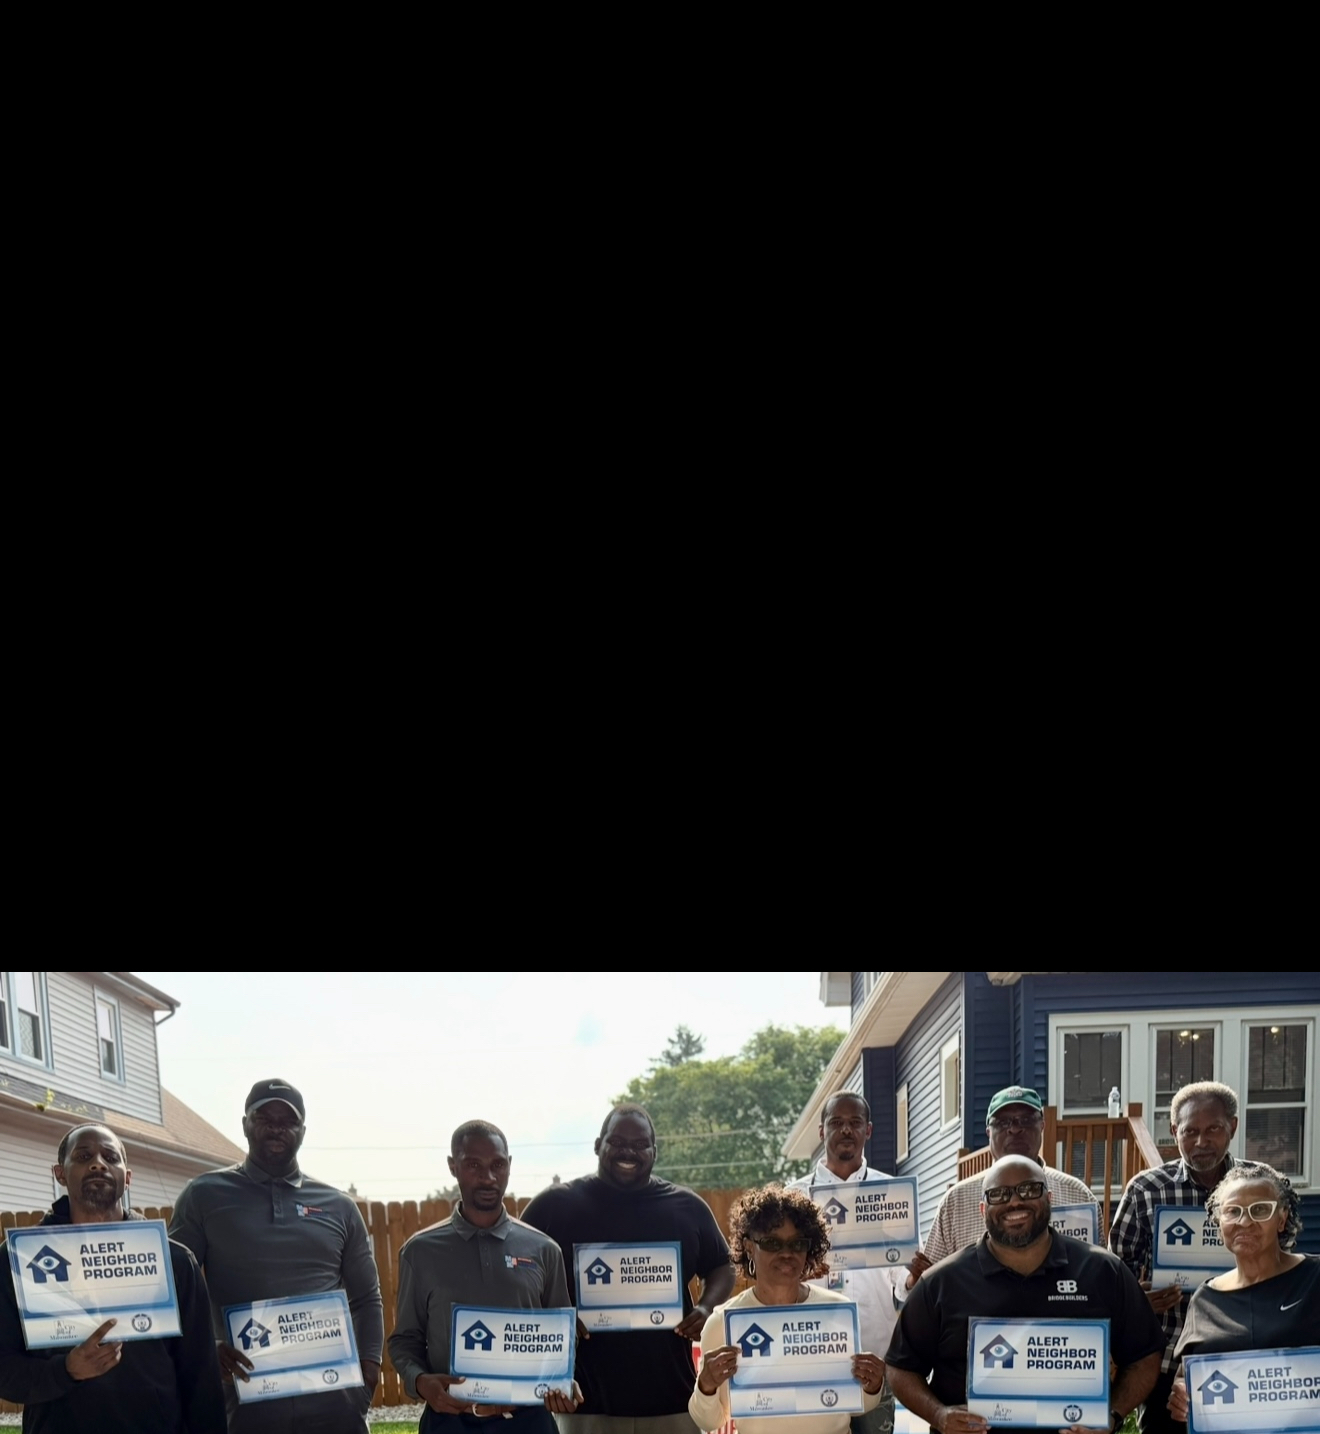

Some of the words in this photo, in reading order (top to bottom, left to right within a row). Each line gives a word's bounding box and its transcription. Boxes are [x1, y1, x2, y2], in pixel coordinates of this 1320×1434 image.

[855, 1193, 887, 1204] ALERT
[855, 1201, 909, 1213] NEIGHBOR
[856, 1211, 908, 1223] PROGRAM
[80, 1242, 124, 1255] ALERT
[81, 1252, 157, 1268] NEIGHBOR
[620, 1256, 651, 1265] ALERT
[84, 1265, 157, 1280] PROGRAM
[620, 1265, 673, 1275] NEIGHBOR
[621, 1274, 672, 1284] PROGRAM
[277, 1311, 313, 1324] ALERT
[279, 1318, 340, 1334] NEIGHBOR
[504, 1323, 541, 1333] ALERT
[782, 1321, 821, 1333] ALERT
[281, 1328, 342, 1344] PROGRAM
[504, 1333, 564, 1343] NEIGHBOR
[783, 1332, 848, 1344] NEIGHBOR
[1027, 1336, 1069, 1346] ALERT
[504, 1343, 562, 1353] PROGRAM
[784, 1343, 847, 1356] PROGRAM
[1027, 1348, 1097, 1358] NEIGHBOR
[1027, 1359, 1096, 1370] PROGRAM
[1247, 1366, 1292, 1379] ALERT
